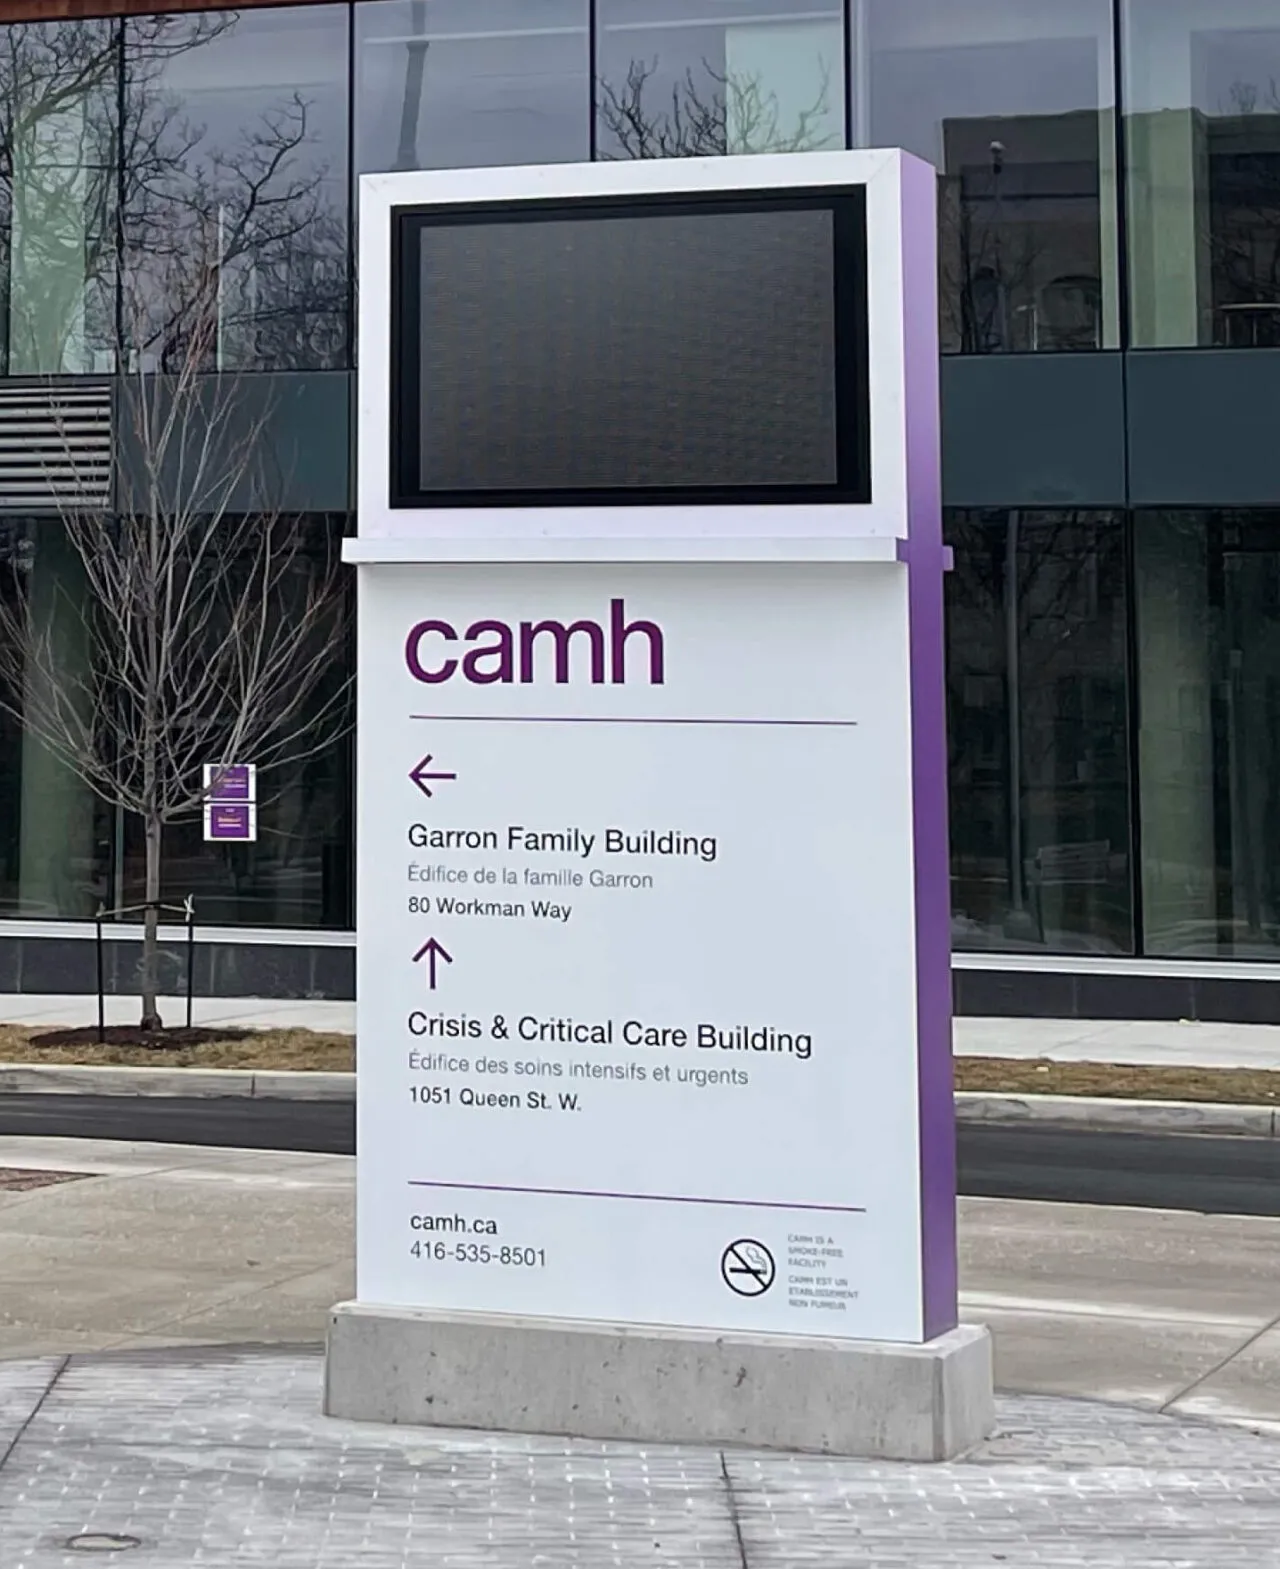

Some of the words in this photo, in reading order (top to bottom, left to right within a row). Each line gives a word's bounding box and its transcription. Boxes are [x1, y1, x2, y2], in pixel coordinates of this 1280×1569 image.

[405, 599, 665, 686] camh
[407, 822, 498, 850] Garron
[507, 826, 596, 858] Family
[605, 829, 718, 862] Building
[407, 860, 469, 885] Édifice
[473, 866, 497, 885] de
[502, 867, 518, 885] la
[523, 868, 584, 888] famille
[589, 868, 654, 890] Garron
[408, 895, 431, 914] 80
[436, 896, 526, 918] Workman
[531, 900, 573, 923] Way
[407, 1010, 483, 1039] Crisis
[490, 1014, 510, 1041] &
[517, 1015, 613, 1045] Critical
[622, 1020, 688, 1049] Care
[697, 1023, 813, 1060] Building
[408, 1048, 470, 1073] Édifice
[475, 1055, 509, 1075] des
[514, 1058, 564, 1077] soins
[568, 1060, 647, 1082] intensifs
[652, 1065, 671, 1083] et
[677, 1067, 749, 1088] urgents
[409, 1085, 451, 1105] 1051
[459, 1087, 521, 1109] Queen
[526, 1090, 553, 1110] St.
[557, 1092, 583, 1112] W.
[409, 1212, 498, 1236] camh.ca
[410, 1239, 547, 1268] 416-535-8501
